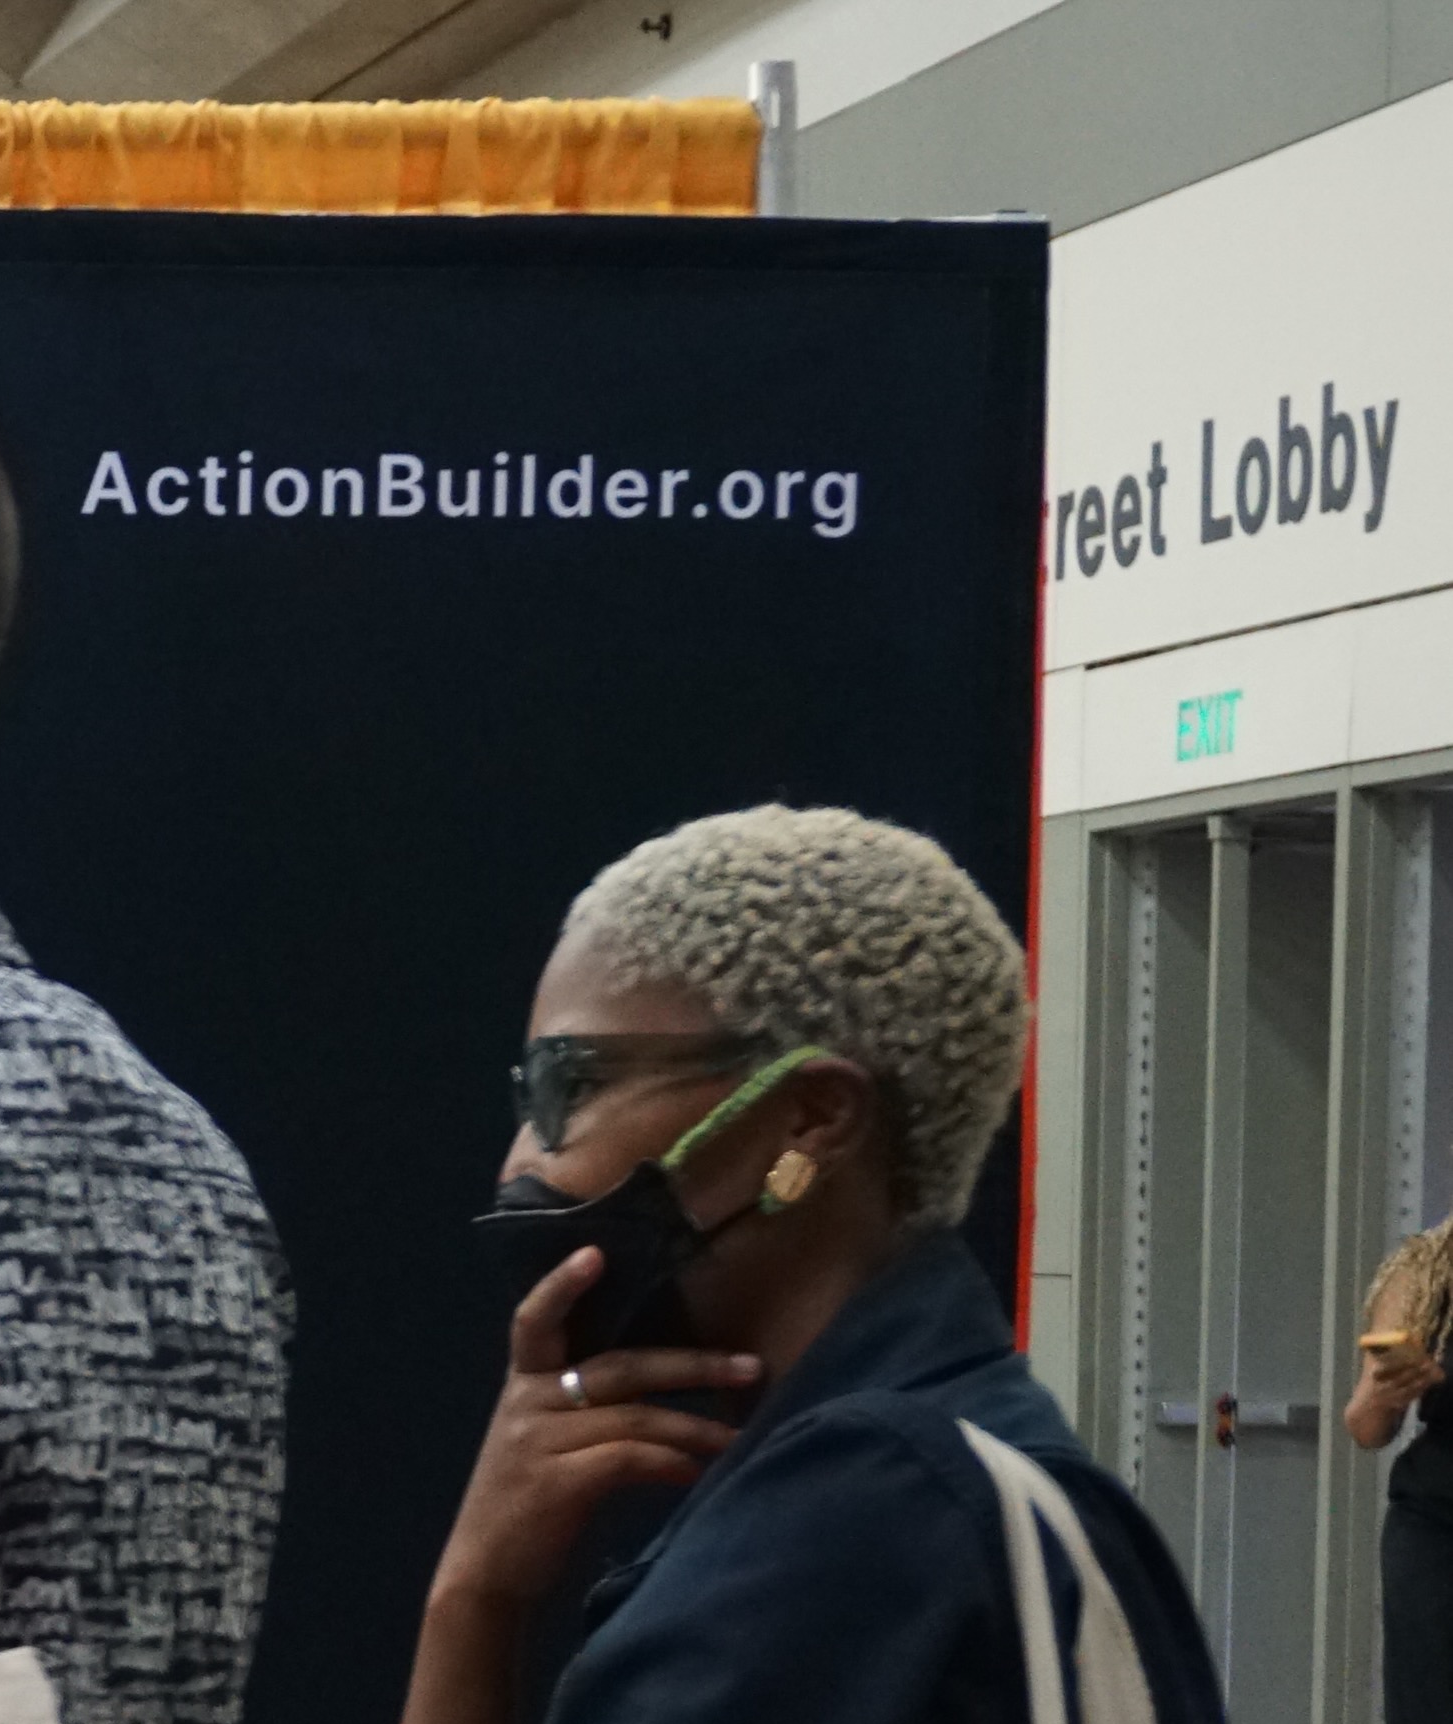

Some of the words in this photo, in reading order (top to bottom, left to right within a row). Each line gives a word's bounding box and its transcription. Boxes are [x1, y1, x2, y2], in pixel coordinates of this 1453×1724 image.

[80, 449, 860, 540] ActionBuilder.org
[1200, 381, 1400, 545] Lobby
[1175, 688, 1243, 763] EXIT
